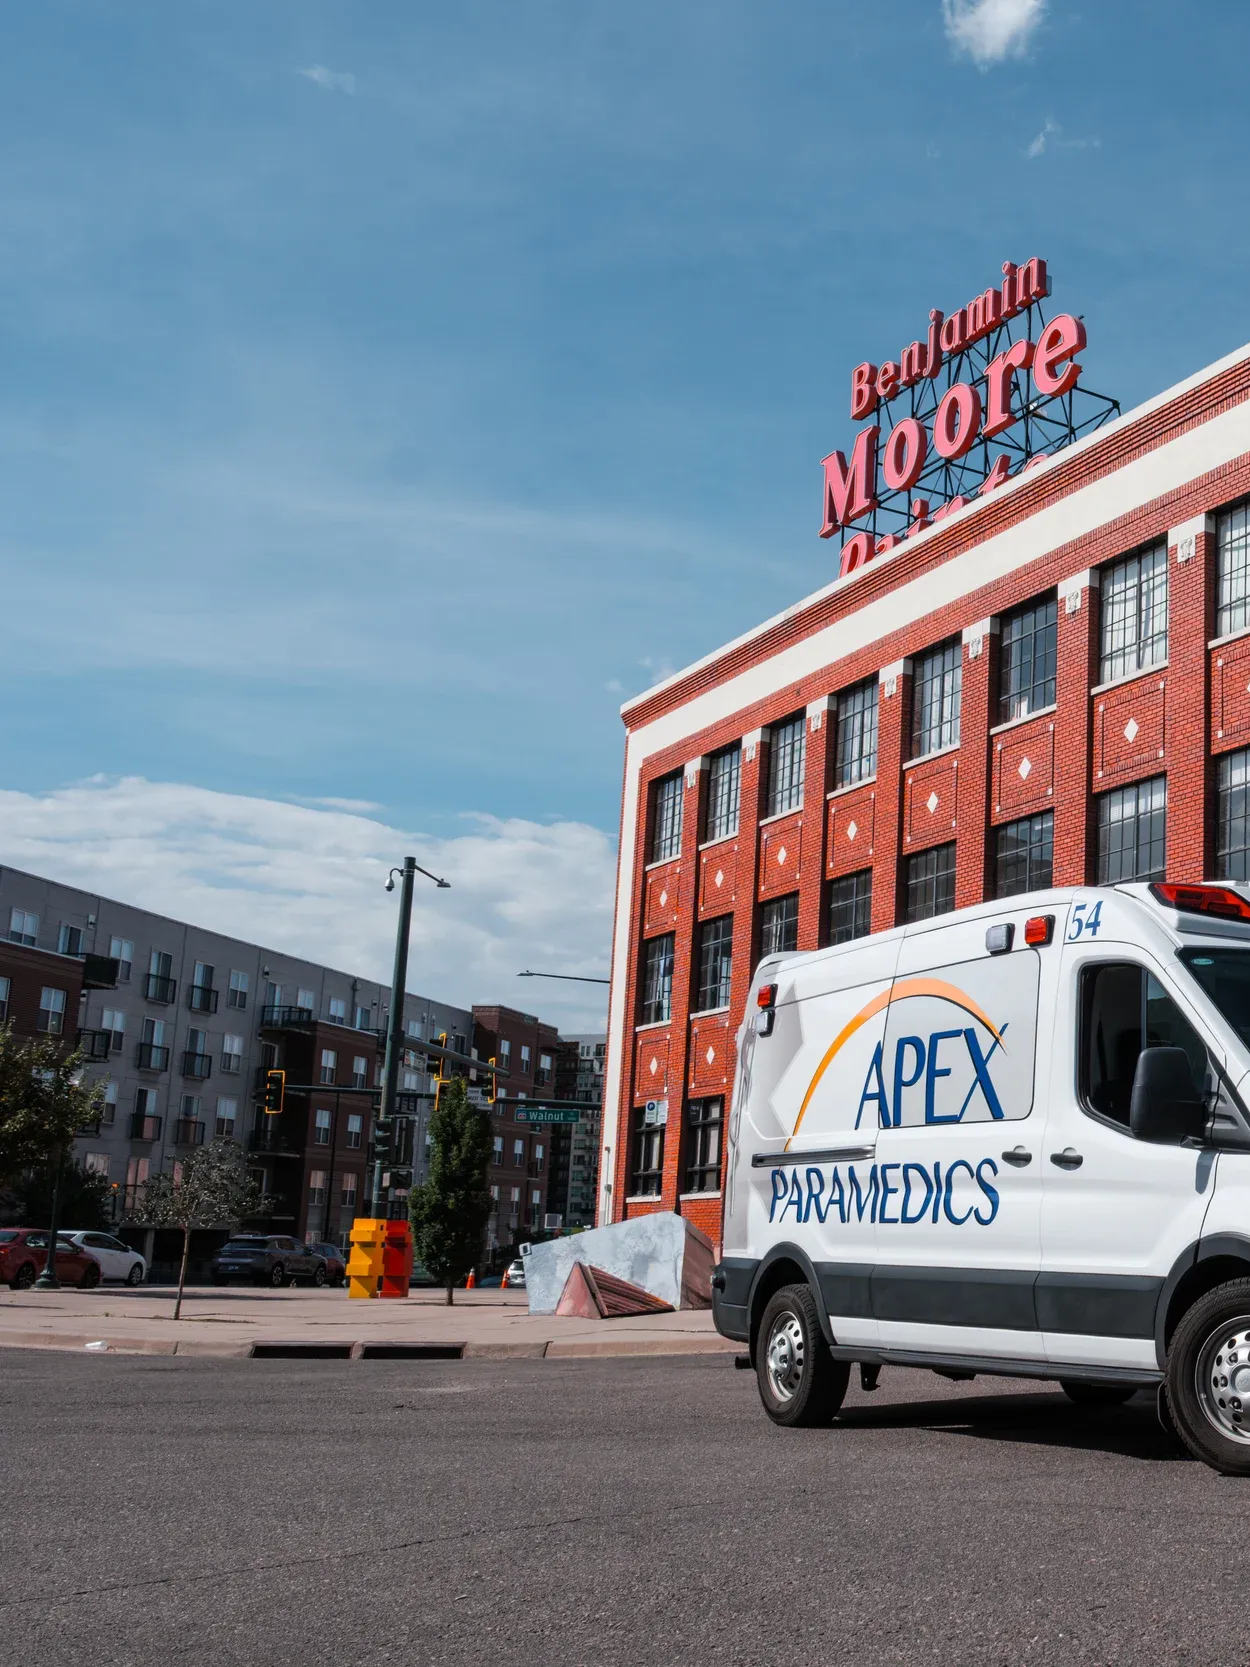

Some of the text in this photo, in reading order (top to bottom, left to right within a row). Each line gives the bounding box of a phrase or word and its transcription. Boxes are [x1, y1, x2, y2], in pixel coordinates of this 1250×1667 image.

[850, 257, 1047, 420] Benjamin
[819, 313, 1087, 539] Moore
[1067, 900, 1103, 941] 54
[529, 1111, 564, 1120] Walnut
[854, 1022, 1008, 1131] APEX
[768, 1158, 1000, 1226] PARAMEDICS
